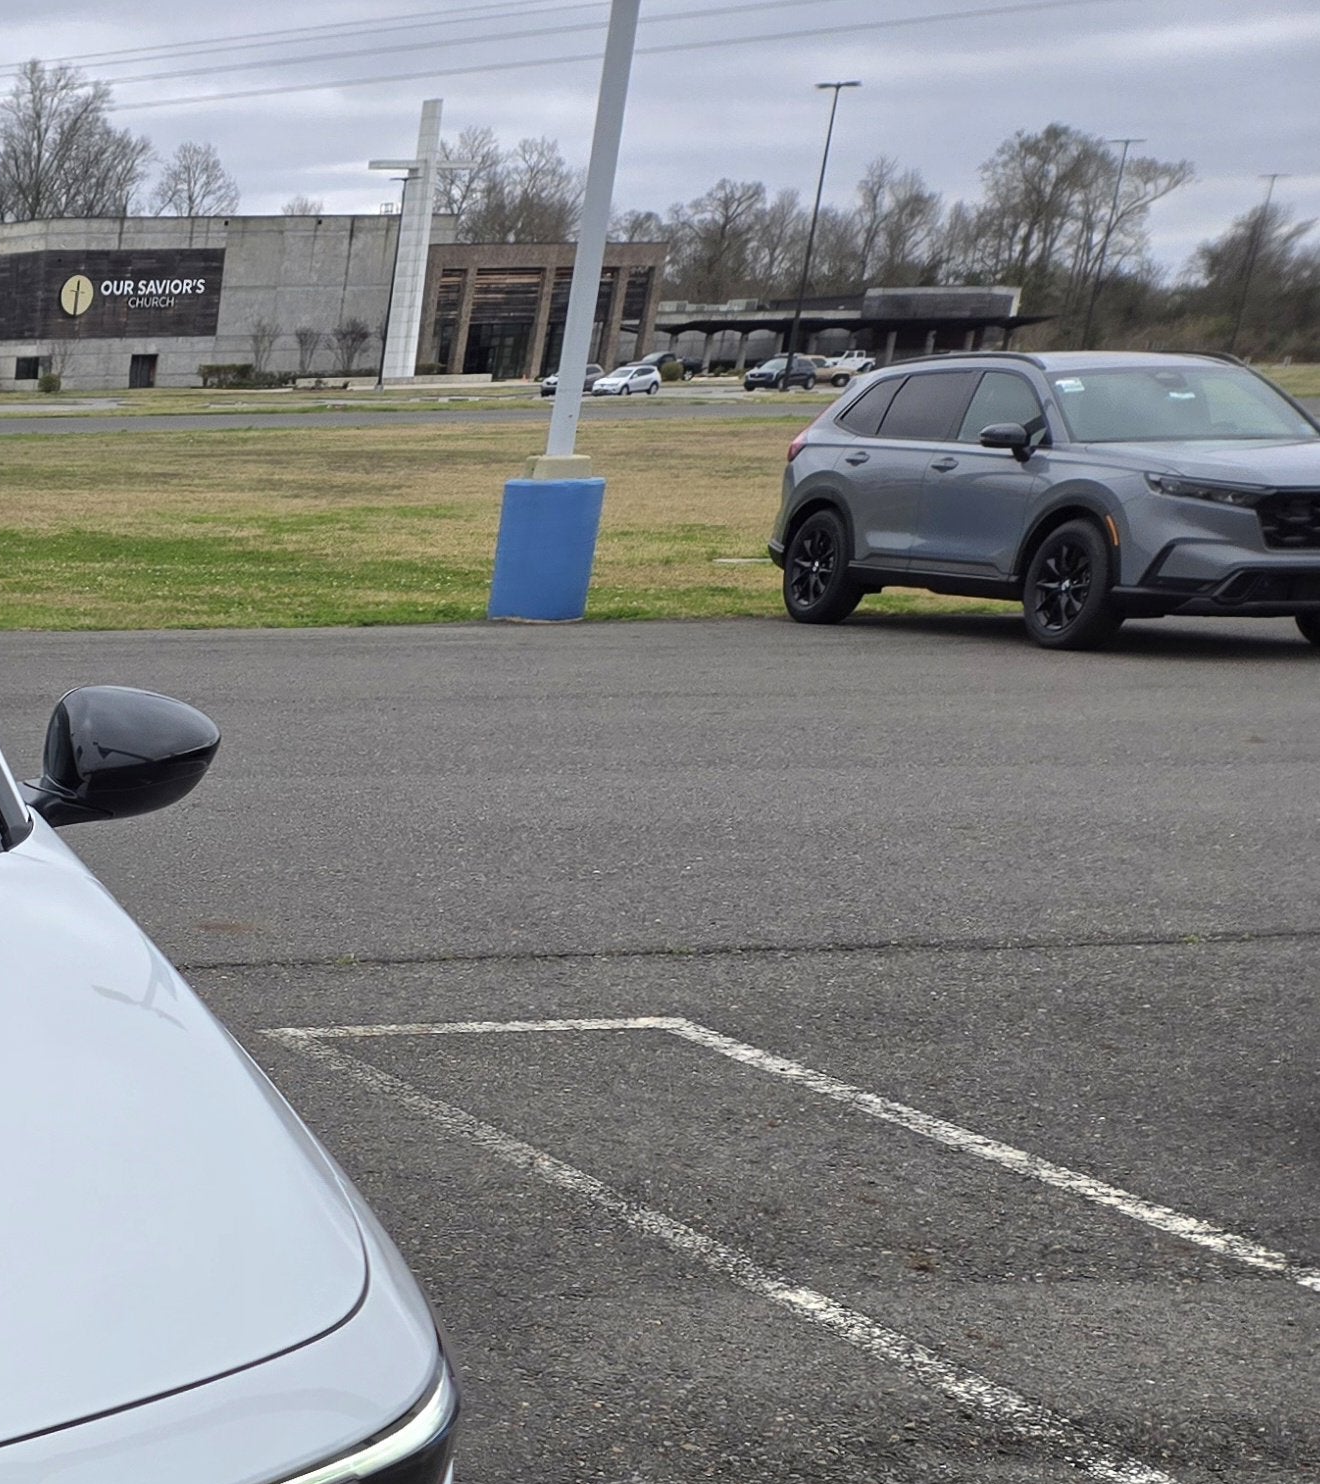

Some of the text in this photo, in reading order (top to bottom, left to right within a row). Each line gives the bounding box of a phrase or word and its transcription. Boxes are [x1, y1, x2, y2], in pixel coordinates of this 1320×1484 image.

[100, 279, 205, 295] OUR SAVIOR'S
[128, 297, 175, 308] CHURCH
